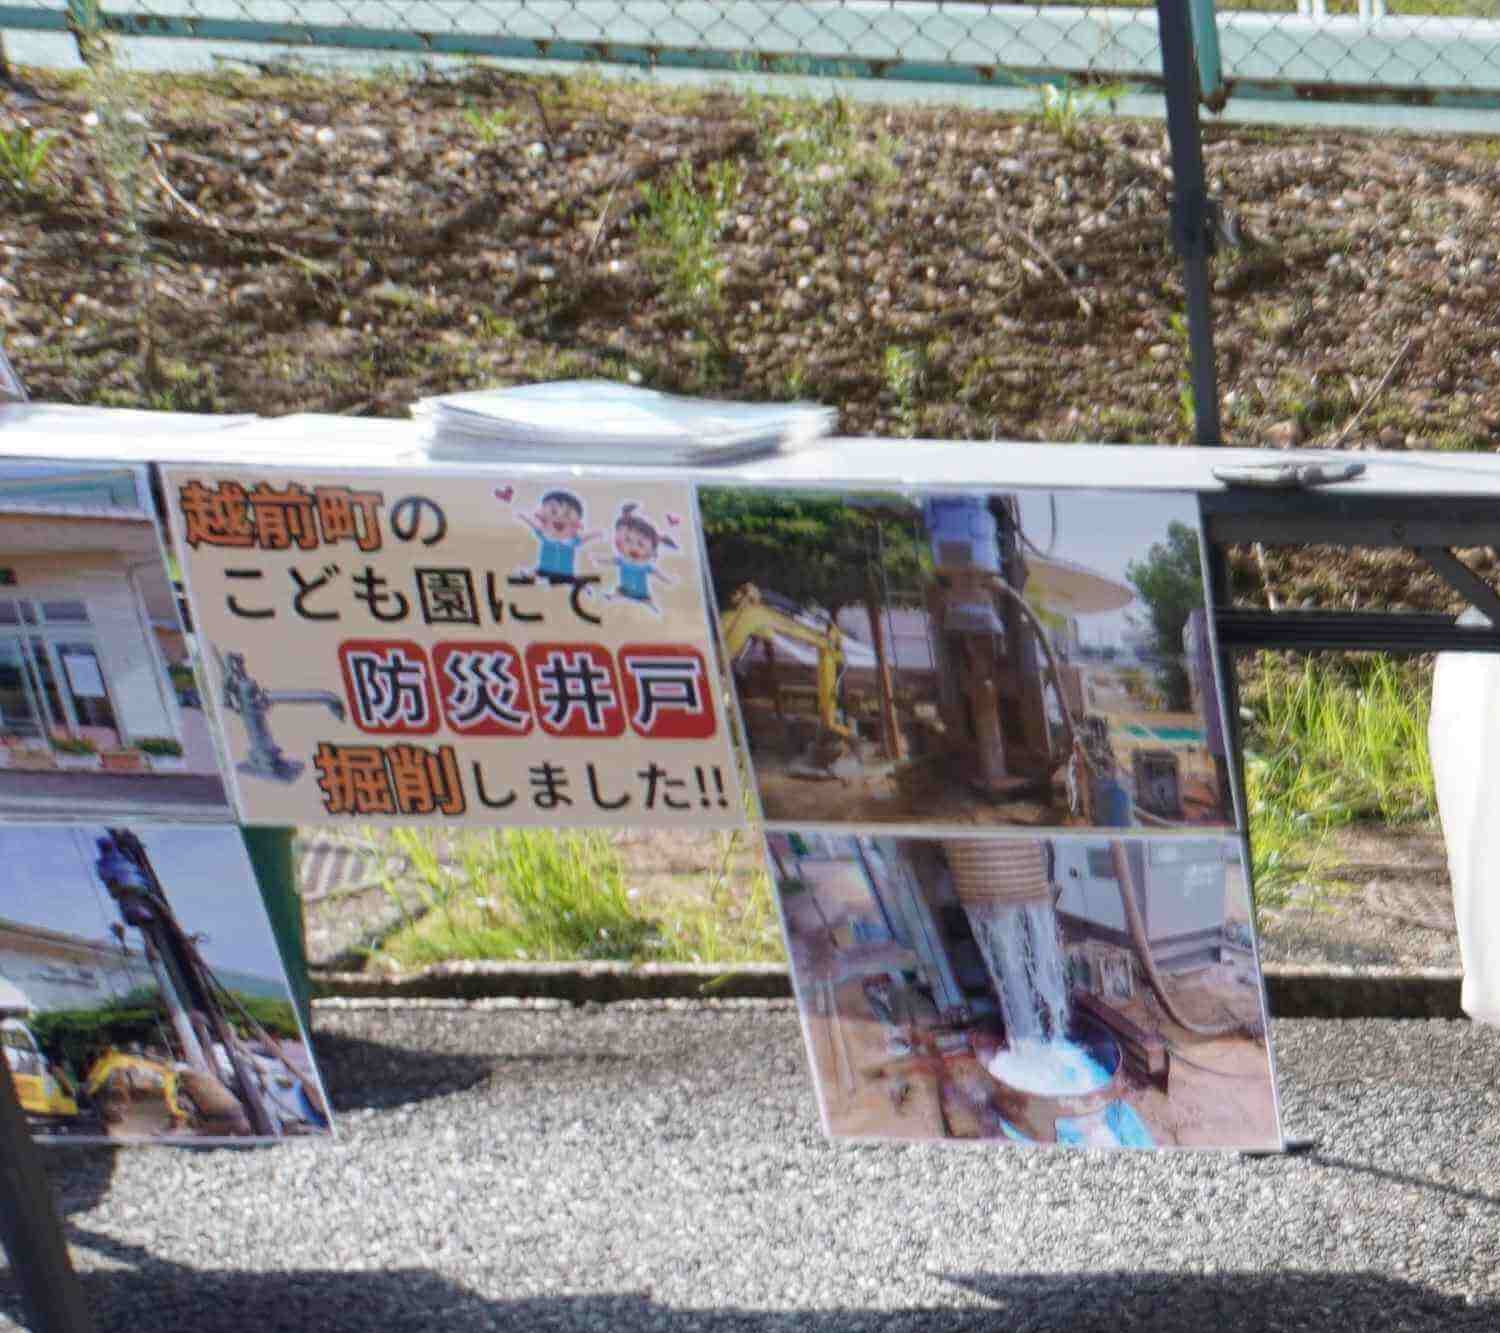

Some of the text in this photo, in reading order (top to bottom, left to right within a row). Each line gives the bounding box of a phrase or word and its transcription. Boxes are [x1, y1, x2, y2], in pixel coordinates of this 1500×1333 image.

[177, 479, 448, 551] 越前町の
[223, 565, 604, 627] こども園にて
[348, 648, 700, 734] 防災井戸
